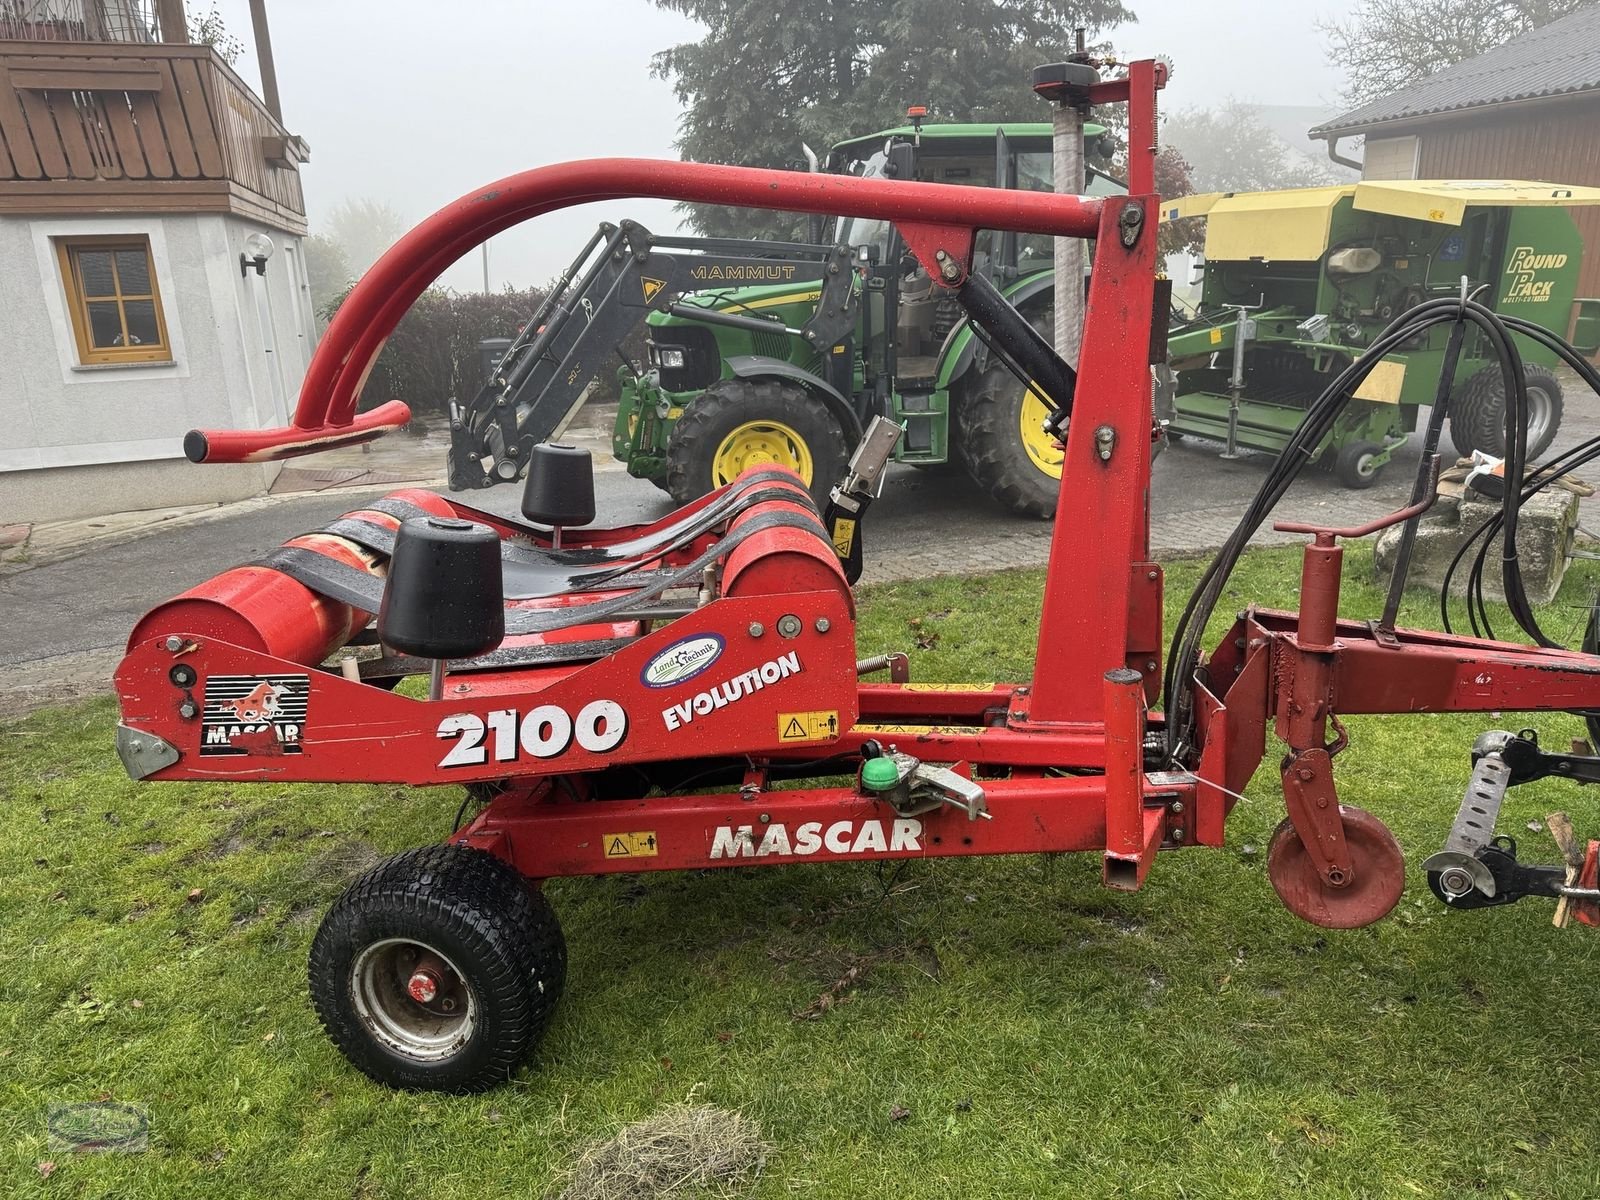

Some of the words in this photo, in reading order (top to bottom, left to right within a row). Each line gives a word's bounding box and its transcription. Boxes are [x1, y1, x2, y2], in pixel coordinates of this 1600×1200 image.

[691, 266, 796, 280] MAMMUT
[1506, 247, 1567, 273] ROUND
[1509, 270, 1555, 297] PACK
[653, 656, 676, 675] Land
[683, 643, 716, 664] Technik
[661, 650, 804, 733] EVOLUTION
[436, 699, 629, 768] 2100
[709, 818, 922, 859] MASCAR
